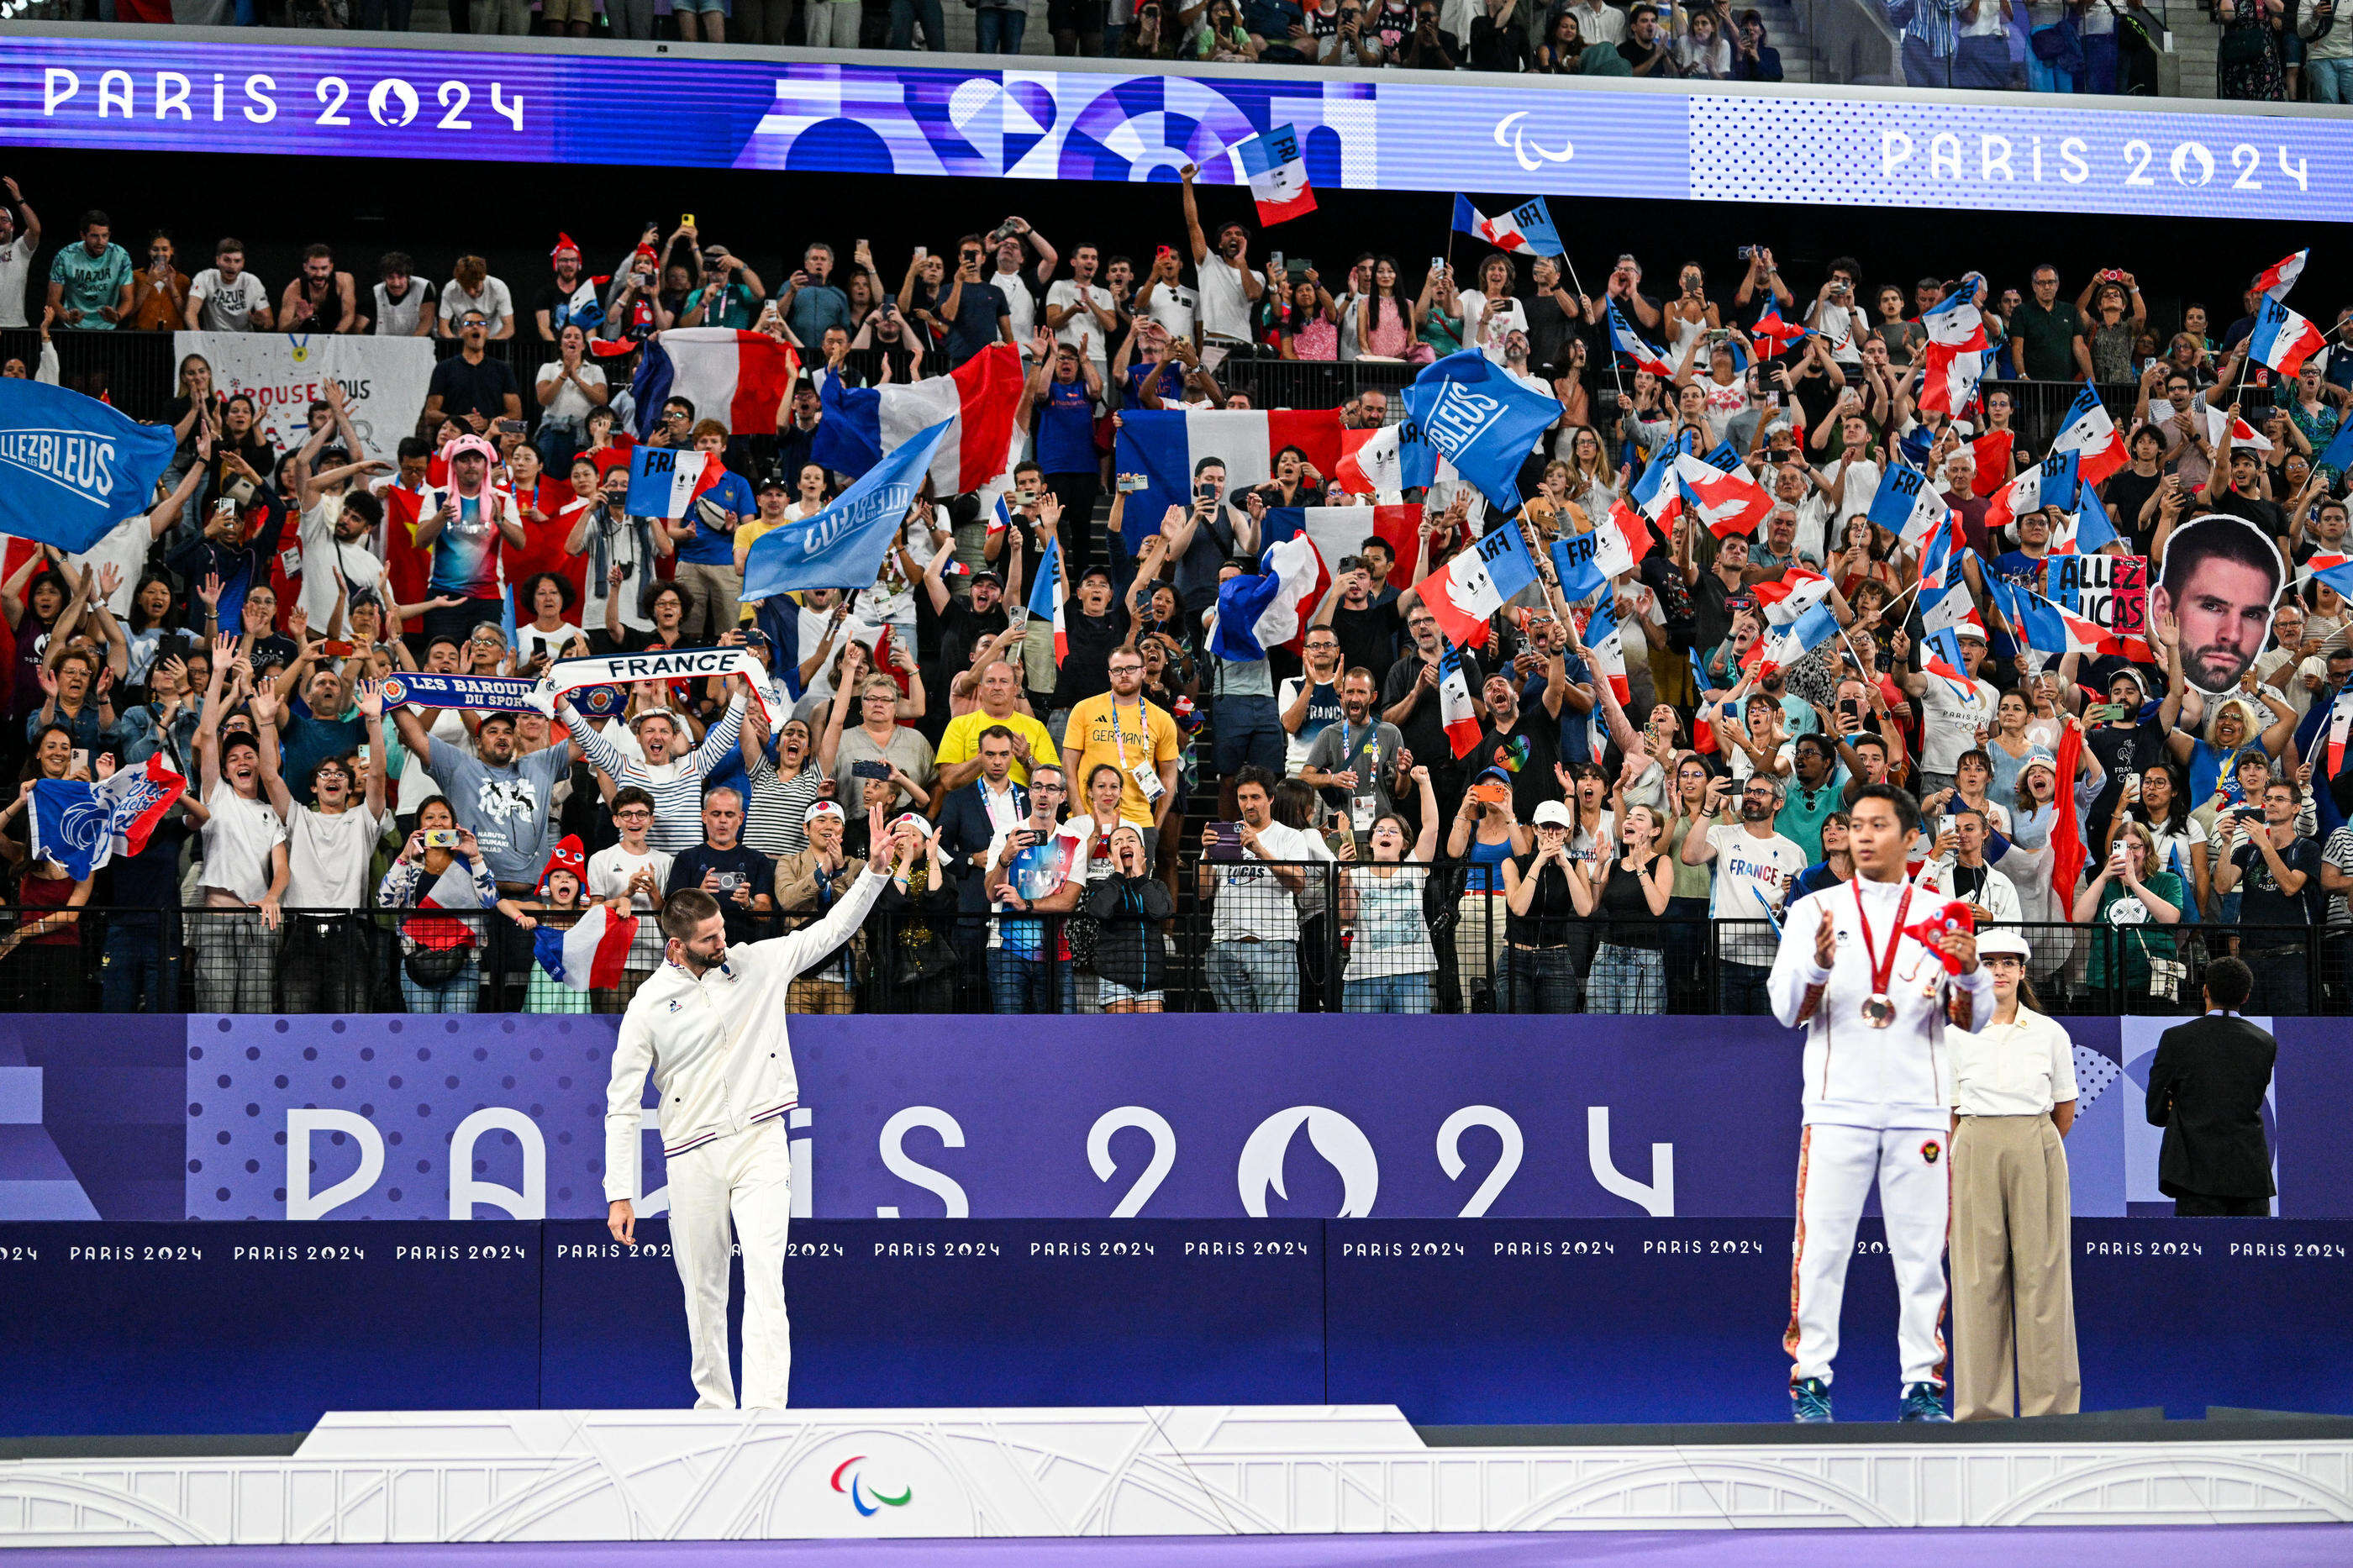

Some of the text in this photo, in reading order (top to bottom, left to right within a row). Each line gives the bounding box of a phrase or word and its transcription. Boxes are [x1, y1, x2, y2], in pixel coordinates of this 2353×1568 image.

[315, 76, 524, 131] 2024
[2123, 139, 2308, 192] 2024
[75, 268, 112, 282] MAZUR
[39, 434, 116, 497] BLEUS
[2060, 558, 2141, 591] ALLEZ
[608, 653, 740, 678] FRANCE
[412, 676, 448, 692] LES
[465, 692, 483, 705] DU
[477, 831, 507, 840] NARUTO
[1729, 859, 1779, 887] FRANCE
[144, 1246, 202, 1260] 2024
[307, 1246, 364, 1260] 2024
[468, 1245, 525, 1260] 2024
[787, 1244, 844, 1257] 2024
[945, 1243, 1000, 1256] 2024
[1100, 1242, 1155, 1256] 2024
[1254, 1242, 1308, 1255] 2024
[1411, 1242, 1464, 1256] 2024
[1561, 1241, 1614, 1255] 2024
[1710, 1240, 1762, 1254] 2024
[2150, 1241, 2202, 1255] 2024
[2294, 1244, 2345, 1257] 2024
